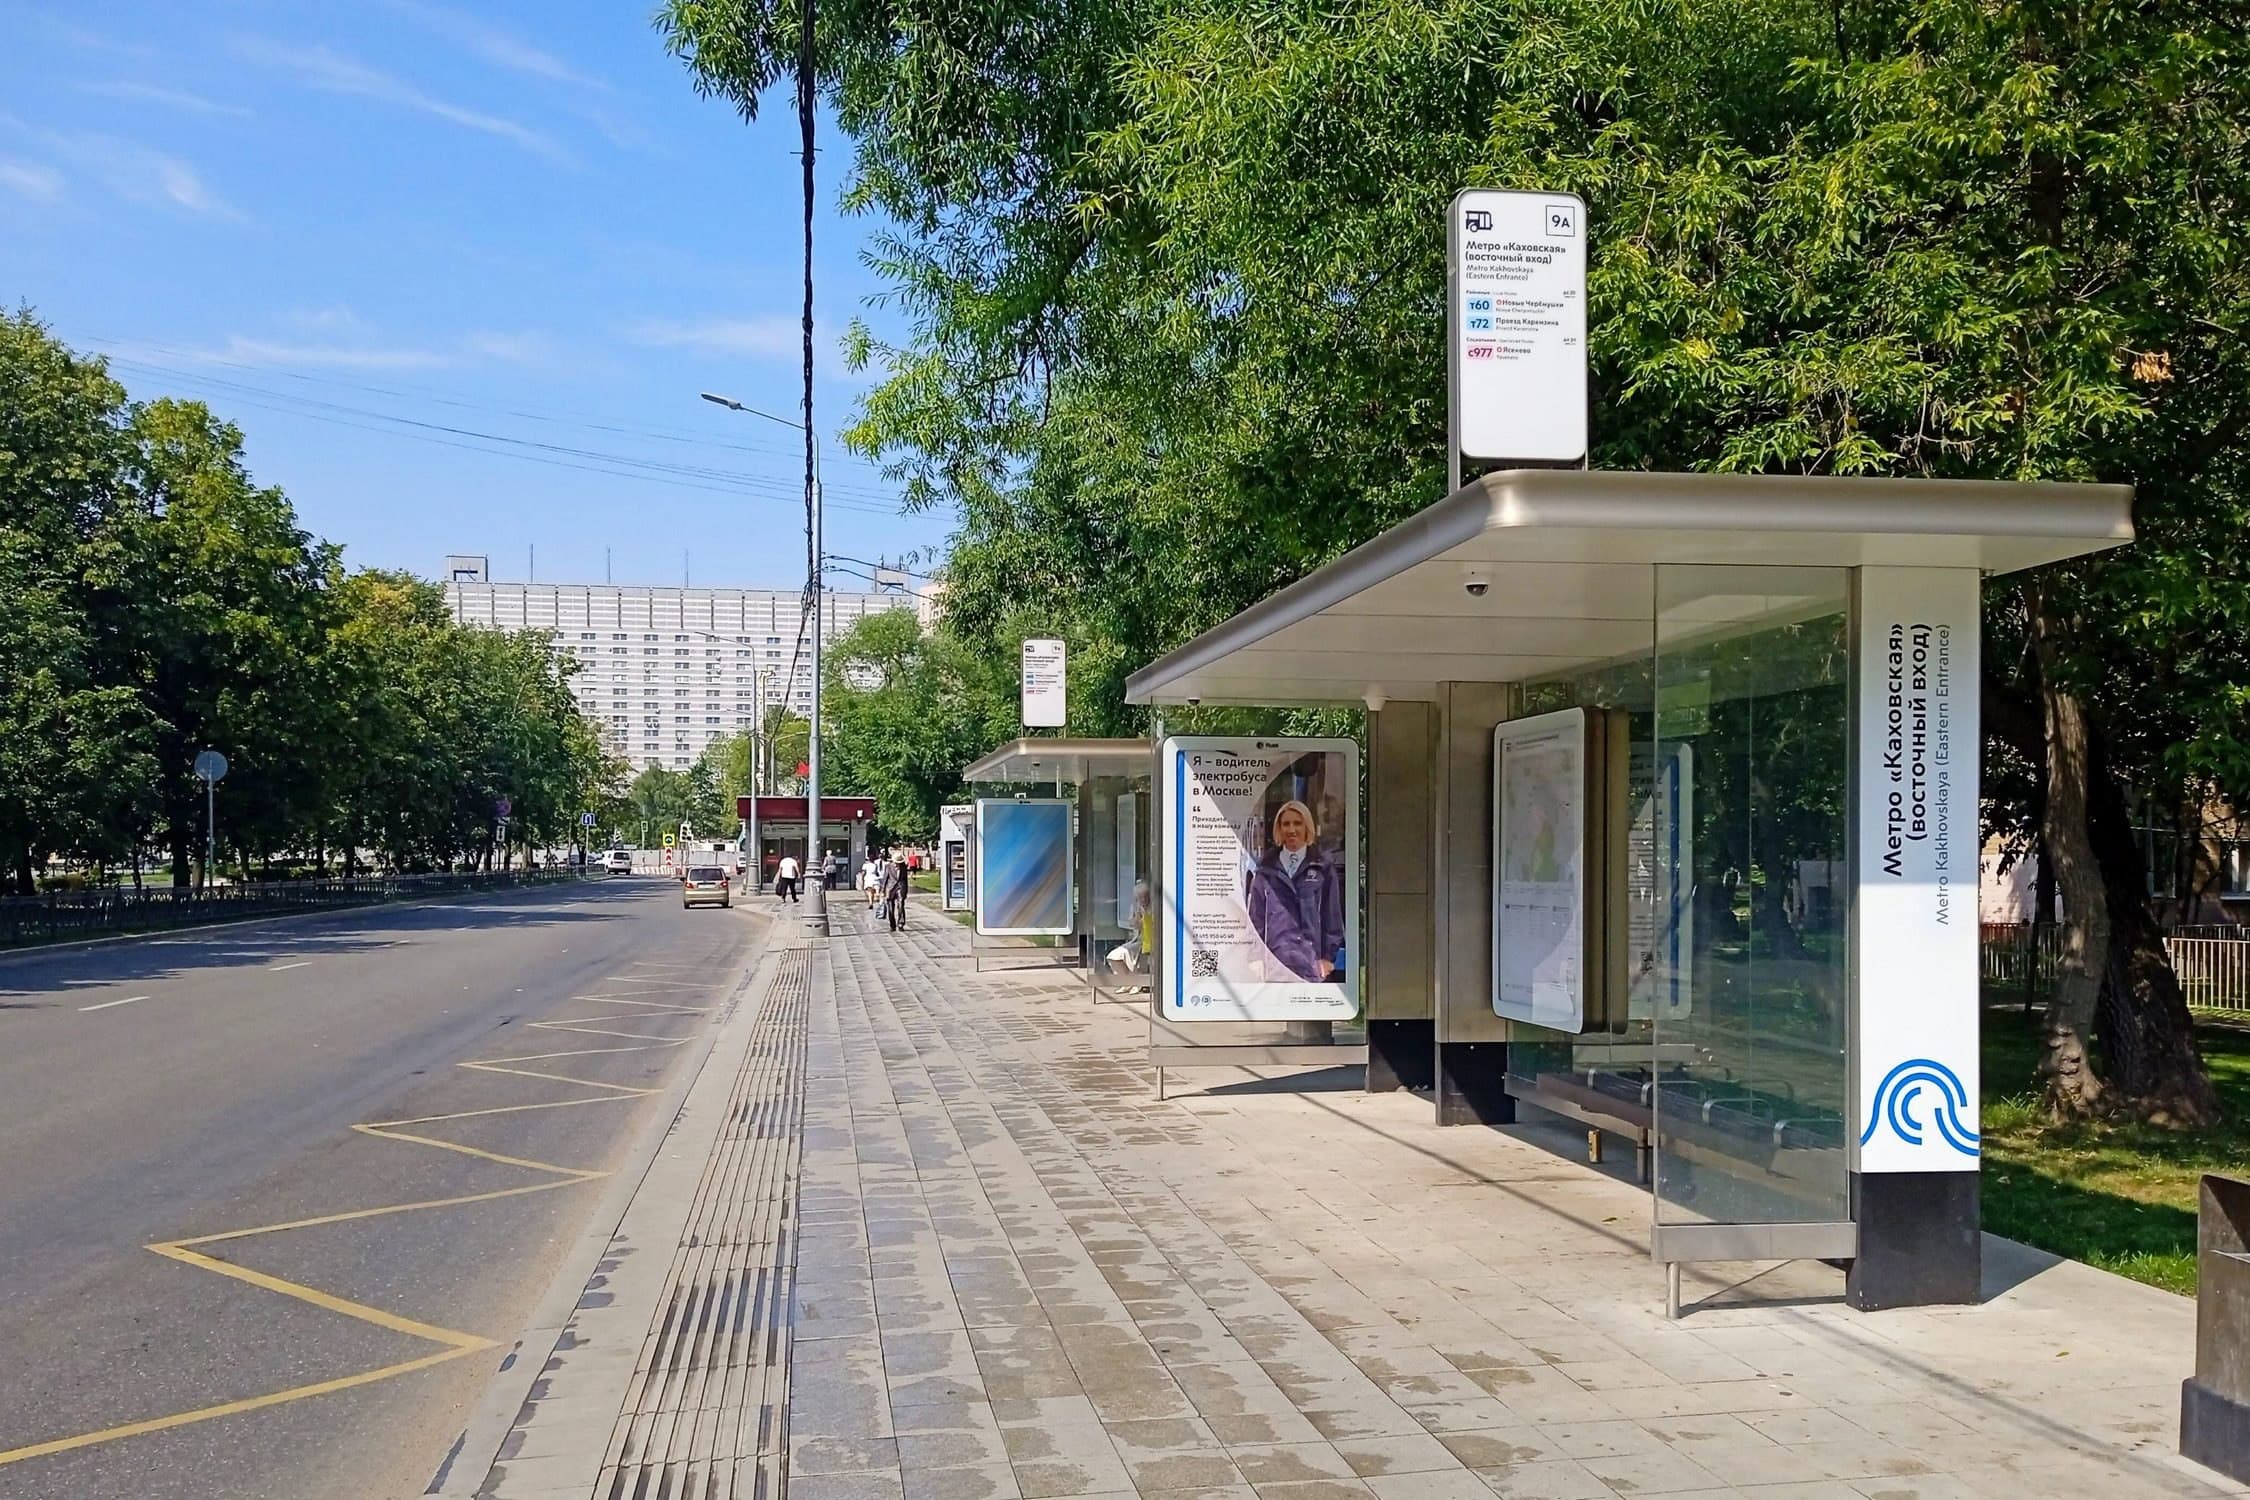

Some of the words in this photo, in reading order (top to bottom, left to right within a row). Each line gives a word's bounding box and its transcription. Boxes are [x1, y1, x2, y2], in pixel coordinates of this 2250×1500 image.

[1465, 251, 1523, 262] (восточный
[1526, 254, 1552, 264] вход)
[1466, 240, 1500, 252] Метро
[1504, 242, 1566, 254] «Каховская»
[1466, 264, 1488, 272] Metro
[1490, 265, 1534, 274] Kakhovskaya
[1466, 272, 1495, 280] (Eastern
[1496, 273, 1529, 281] Entrance)
[1910, 624, 1932, 690] вход)
[1936, 624, 1951, 697] Entrance)
[1884, 624, 1903, 782] «Каховская»
[1934, 702, 1949, 766] (Eastern
[1193, 756, 1201, 766] Я
[1215, 759, 1271, 768] водитель
[1193, 771, 1267, 784] электробуса
[1905, 698, 1928, 840] (восточный
[1193, 788, 1200, 796] в
[1202, 785, 1253, 796] Москве!
[1883, 792, 1906, 877] Метро
[1934, 771, 1951, 870] Kakhovskaya
[1936, 876, 1949, 925] Metro
